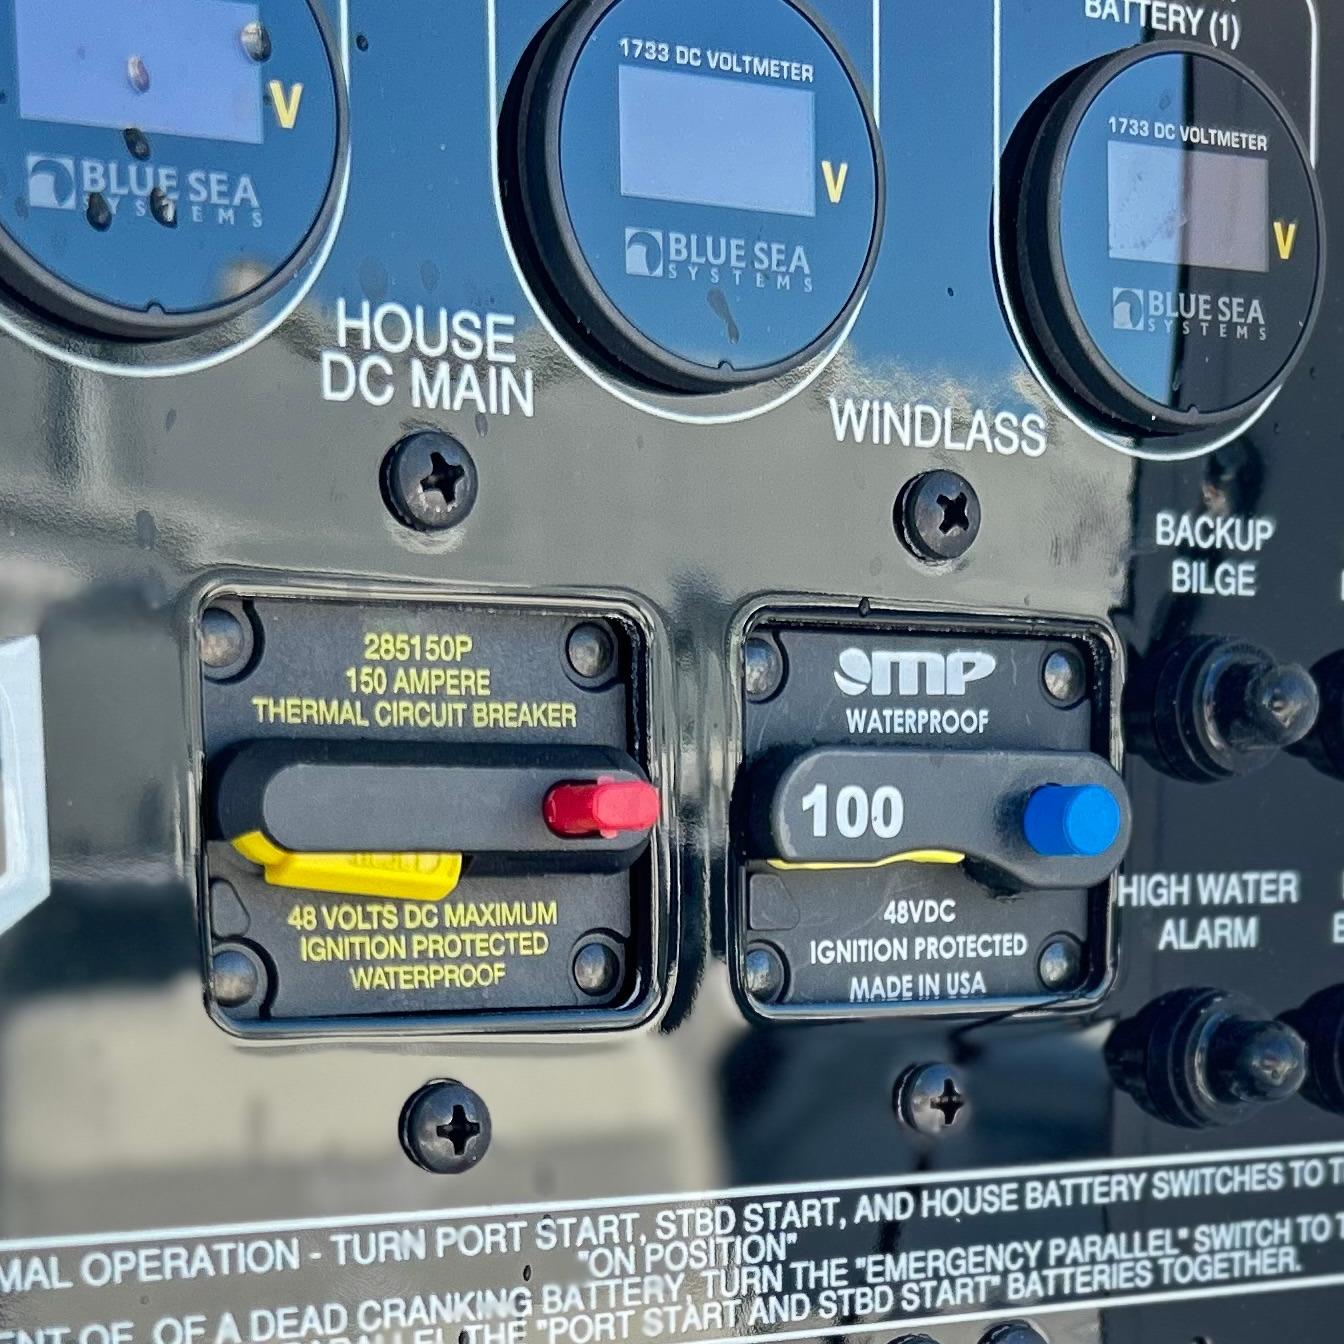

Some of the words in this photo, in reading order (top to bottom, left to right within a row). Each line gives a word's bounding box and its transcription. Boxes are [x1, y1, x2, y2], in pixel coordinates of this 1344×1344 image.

[1084, 0, 1205, 36] BATTERY
[1209, 11, 1241, 50] (1)
[619, 37, 669, 63] 1733
[675, 45, 702, 68] DC
[707, 49, 814, 82] VOLTMETER
[268, 81, 303, 129] V
[1107, 116, 1150, 137] 1733
[1154, 119, 1175, 141] DC
[1179, 124, 1268, 152] VOLTMETER
[82, 159, 180, 200] BLUE
[188, 170, 260, 208] SEA
[821, 160, 848, 204] V
[669, 232, 747, 269] BLUE
[753, 241, 810, 275] SEA
[1272, 221, 1296, 260] V
[669, 263, 813, 293] SYSTEMS
[1148, 289, 1212, 322] BLUE
[1218, 295, 1265, 326] SEA
[337, 298, 516, 363] HOUSE
[1148, 315, 1268, 342] SYSTEMS
[321, 351, 395, 405] DC
[410, 360, 535, 417] MAIN
[829, 398, 1046, 458] WINDLASS
[1155, 513, 1275, 551] BACKUP
[1171, 560, 1257, 597] BILGE
[364, 632, 473, 662] 285150P
[345, 668, 387, 695] 150
[393, 669, 491, 696] AMPERE
[251, 697, 370, 727] THERMAL
[374, 702, 468, 728] CIRCUIT
[473, 703, 577, 729] BREAKER
[846, 708, 990, 734] WATERPROOF
[802, 784, 904, 838] 100
[1118, 873, 1190, 907] HIGH
[1197, 871, 1300, 905] WATER
[287, 904, 317, 930] 48
[321, 903, 398, 929] VOLTS
[404, 903, 438, 928] DC
[443, 901, 558, 927] MAXIMUM
[883, 899, 956, 924] 48VDC
[300, 935, 407, 962] IGNITION
[412, 931, 549, 959] PROTECTED
[810, 939, 908, 965] IGNITION
[914, 933, 1028, 960] PROTECTED
[1158, 916, 1258, 950] ALARM
[349, 962, 506, 990] WATERPROOF
[849, 975, 915, 1002] MADE
[918, 974, 940, 999] IN
[944, 971, 986, 997] USA
[80, 1237, 300, 1288] OPERATION
[329, 1225, 426, 1265] TURN
[436, 1221, 527, 1258] PORT
[535, 1212, 646, 1250] START,
[656, 1203, 736, 1240] STBD
[743, 1197, 847, 1232] START,
[854, 1191, 914, 1224] AND
[921, 1182, 1018, 1218] HOUSE
[1025, 1173, 1147, 1210] BATTERY
[1152, 1162, 1285, 1199] SWITCHES
[1291, 1158, 1324, 1187] TO
[577, 1248, 636, 1278] "ON
[644, 1232, 797, 1271] POSITION"
[251, 1303, 347, 1343] DEAD
[357, 1286, 532, 1332] CRANKING
[542, 1271, 693, 1315] BATTERY,
[700, 1262, 783, 1298] TURN
[791, 1258, 847, 1288] THE
[855, 1239, 1043, 1284] "EMERGENCY
[1049, 1228, 1189, 1266] PARALLEL"
[1193, 1220, 1291, 1252] SWITCH
[1296, 1214, 1329, 1242] TO
[642, 1300, 741, 1337] START
[748, 1293, 809, 1326] AND
[818, 1284, 895, 1316] STBD
[902, 1277, 1001, 1312] START"
[1007, 1262, 1153, 1301] BATTERIES
[1158, 1247, 1303, 1284] TOGETHER.
